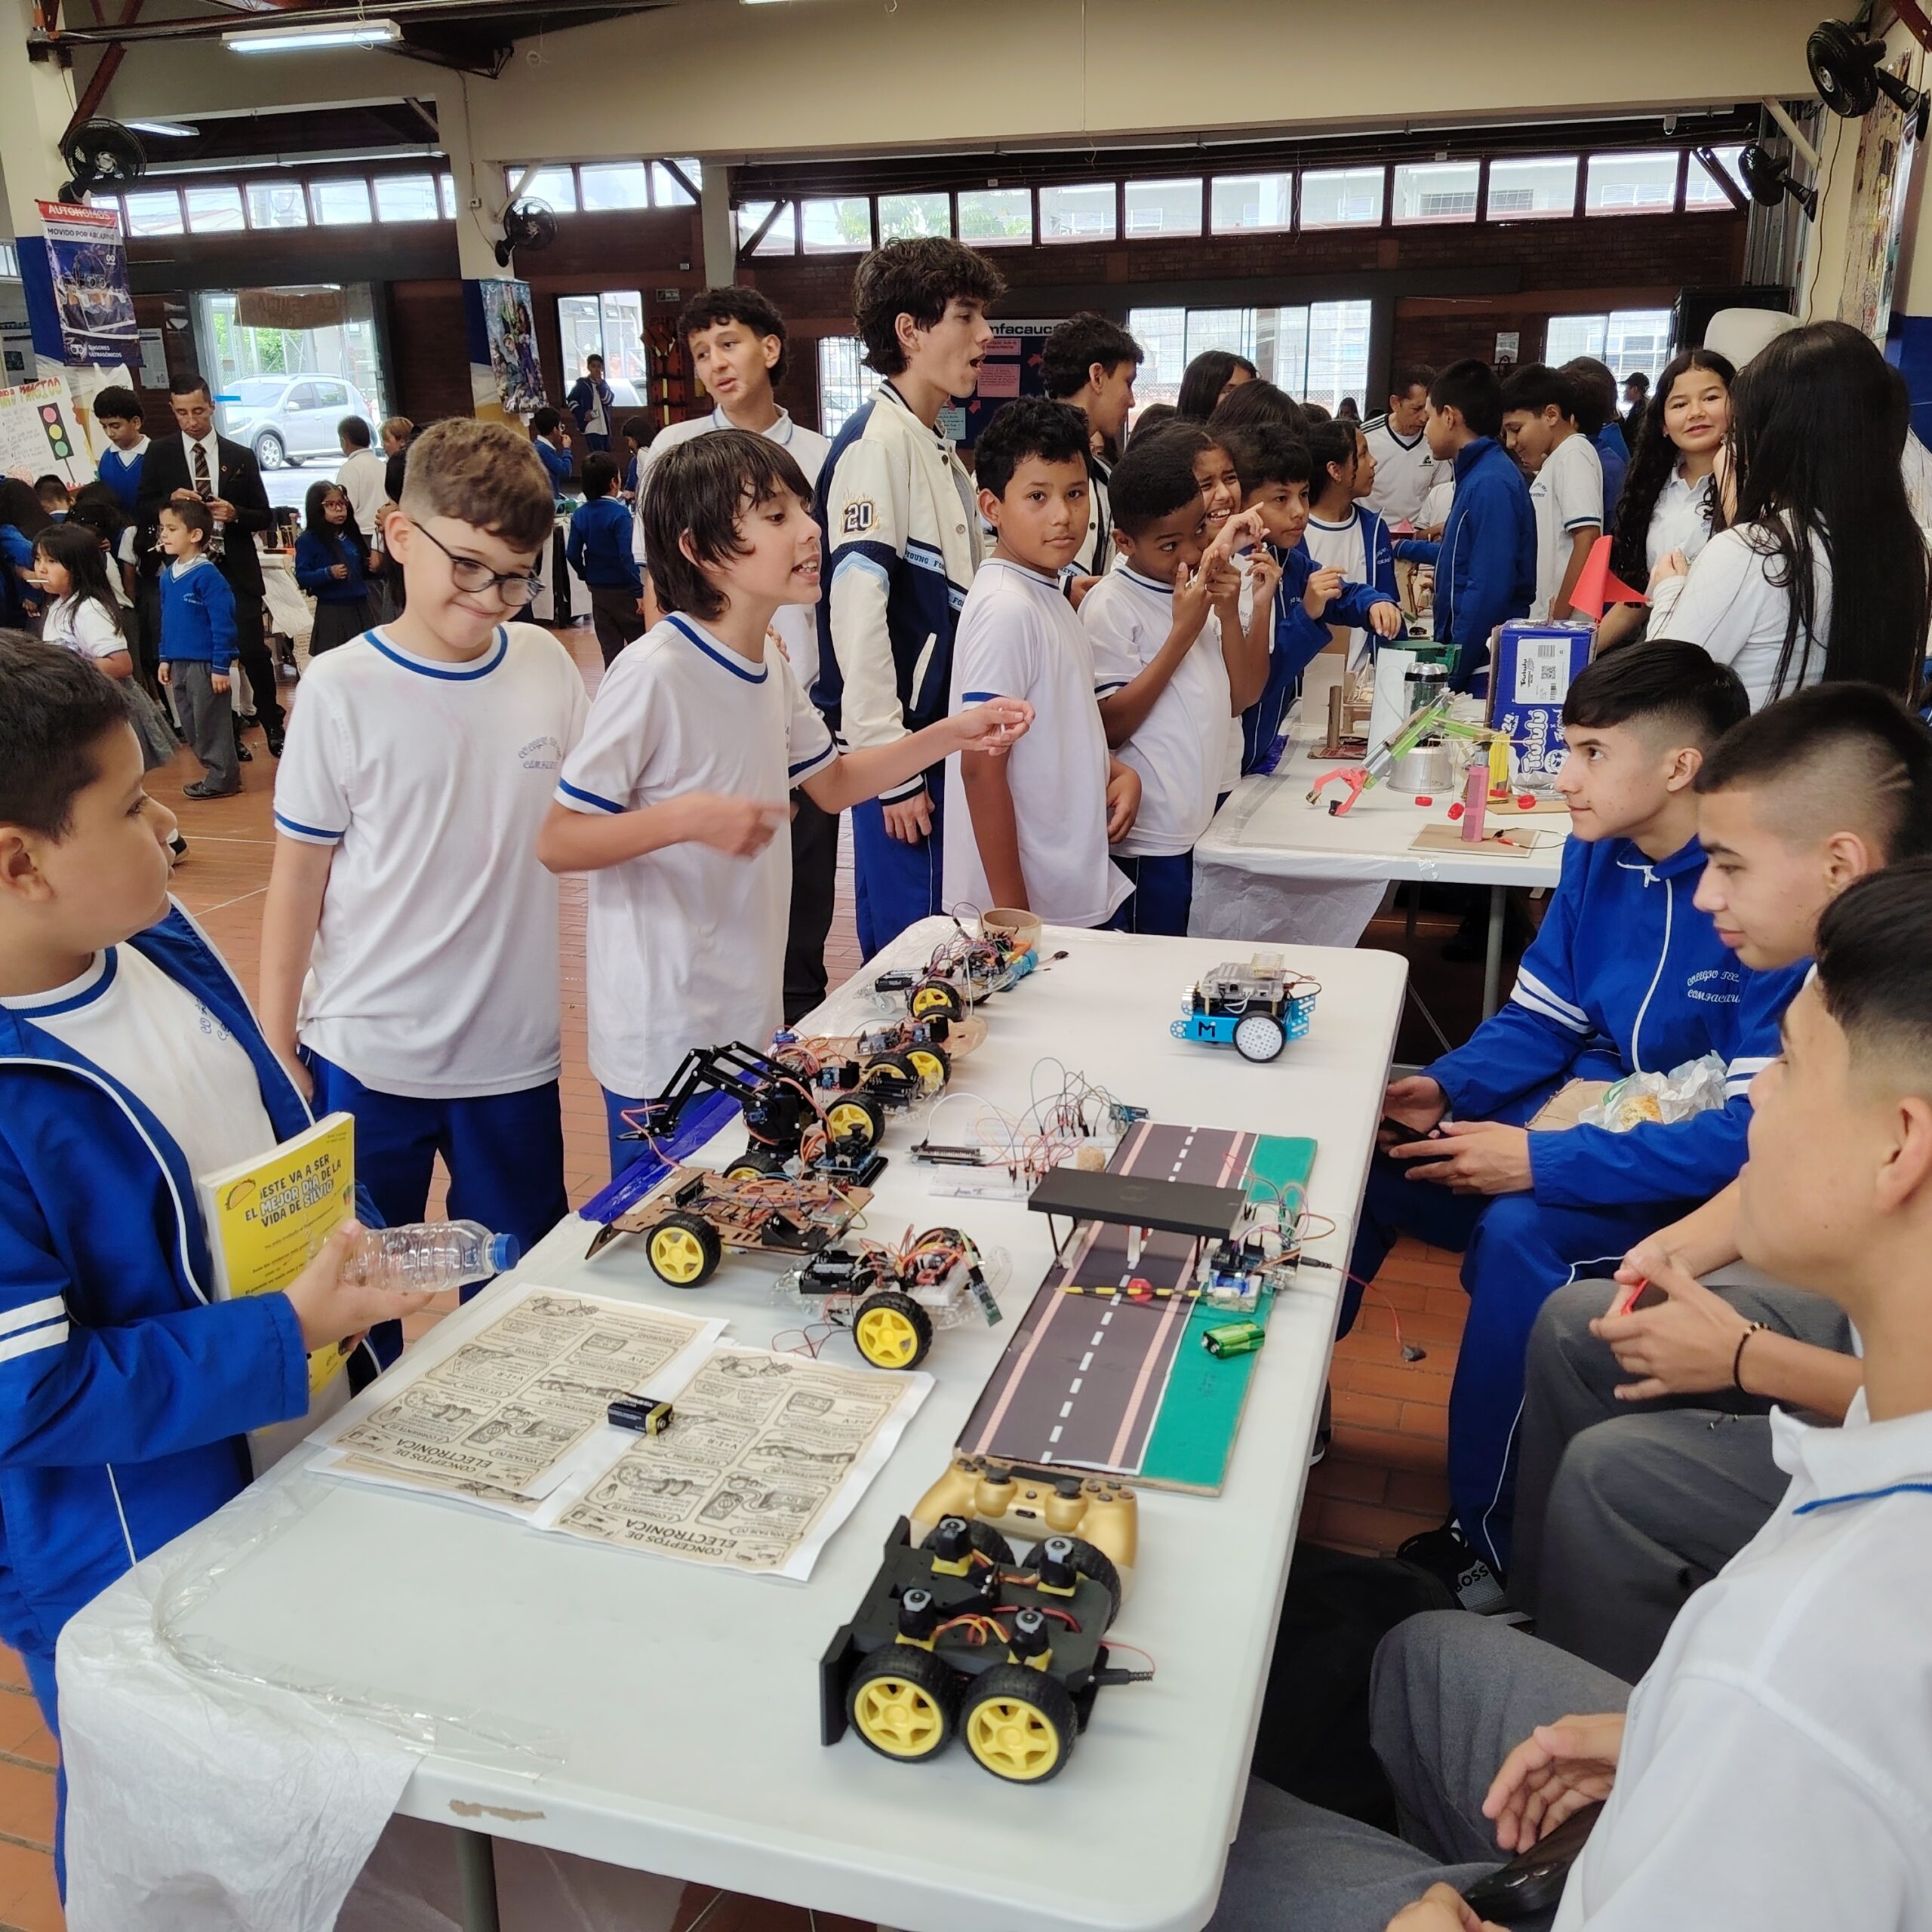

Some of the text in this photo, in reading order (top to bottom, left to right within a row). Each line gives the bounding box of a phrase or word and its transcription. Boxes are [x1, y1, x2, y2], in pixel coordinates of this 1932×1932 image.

[48, 228, 74, 236] MOVIDO
[844, 501, 875, 533] 20
[1521, 708, 1549, 774] Trululu
[1687, 989, 1740, 1003] COMFACAU
[1198, 1020, 1215, 1038] M
[289, 1170, 303, 1183] VA
[306, 1164, 312, 1177] A
[314, 1153, 330, 1171] SER
[245, 1208, 258, 1221] EL
[260, 1186, 300, 1217] MEJOR
[321, 1165, 331, 1181] DE
[332, 1158, 342, 1173] LA
[261, 1208, 288, 1228] VIDA
[289, 1199, 302, 1214] DE
[390, 1447, 477, 1475] CONCEPTOS DE
[391, 1438, 493, 1470] ELECTRÓNICA
[618, 1518, 739, 1550] ELECTRÓNICA
[622, 1531, 724, 1556] CONCEPTOS DE
